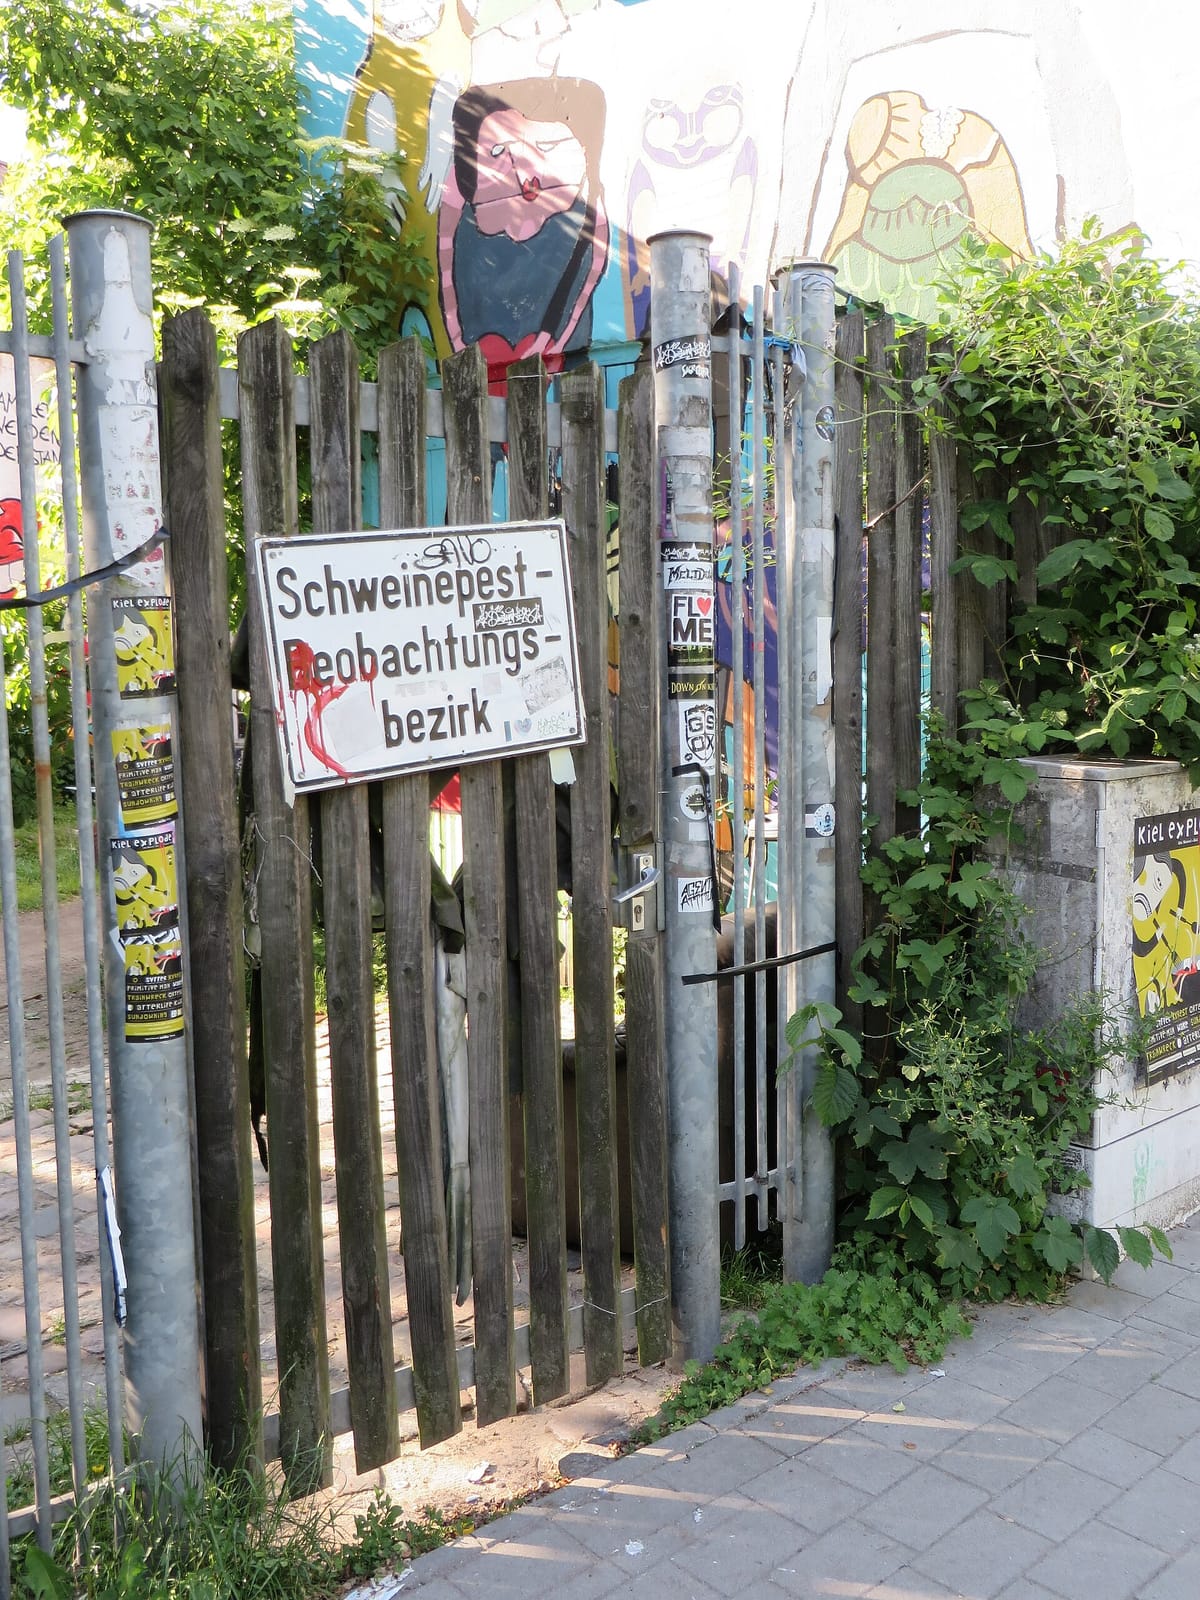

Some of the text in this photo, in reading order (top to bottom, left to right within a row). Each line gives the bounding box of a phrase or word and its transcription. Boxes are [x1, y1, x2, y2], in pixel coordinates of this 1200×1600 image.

[277, 550, 553, 619] Schweinepest-
[673, 617, 713, 642] ME
[671, 682, 695, 694] DOWN
[381, 688, 492, 749] bezirk
